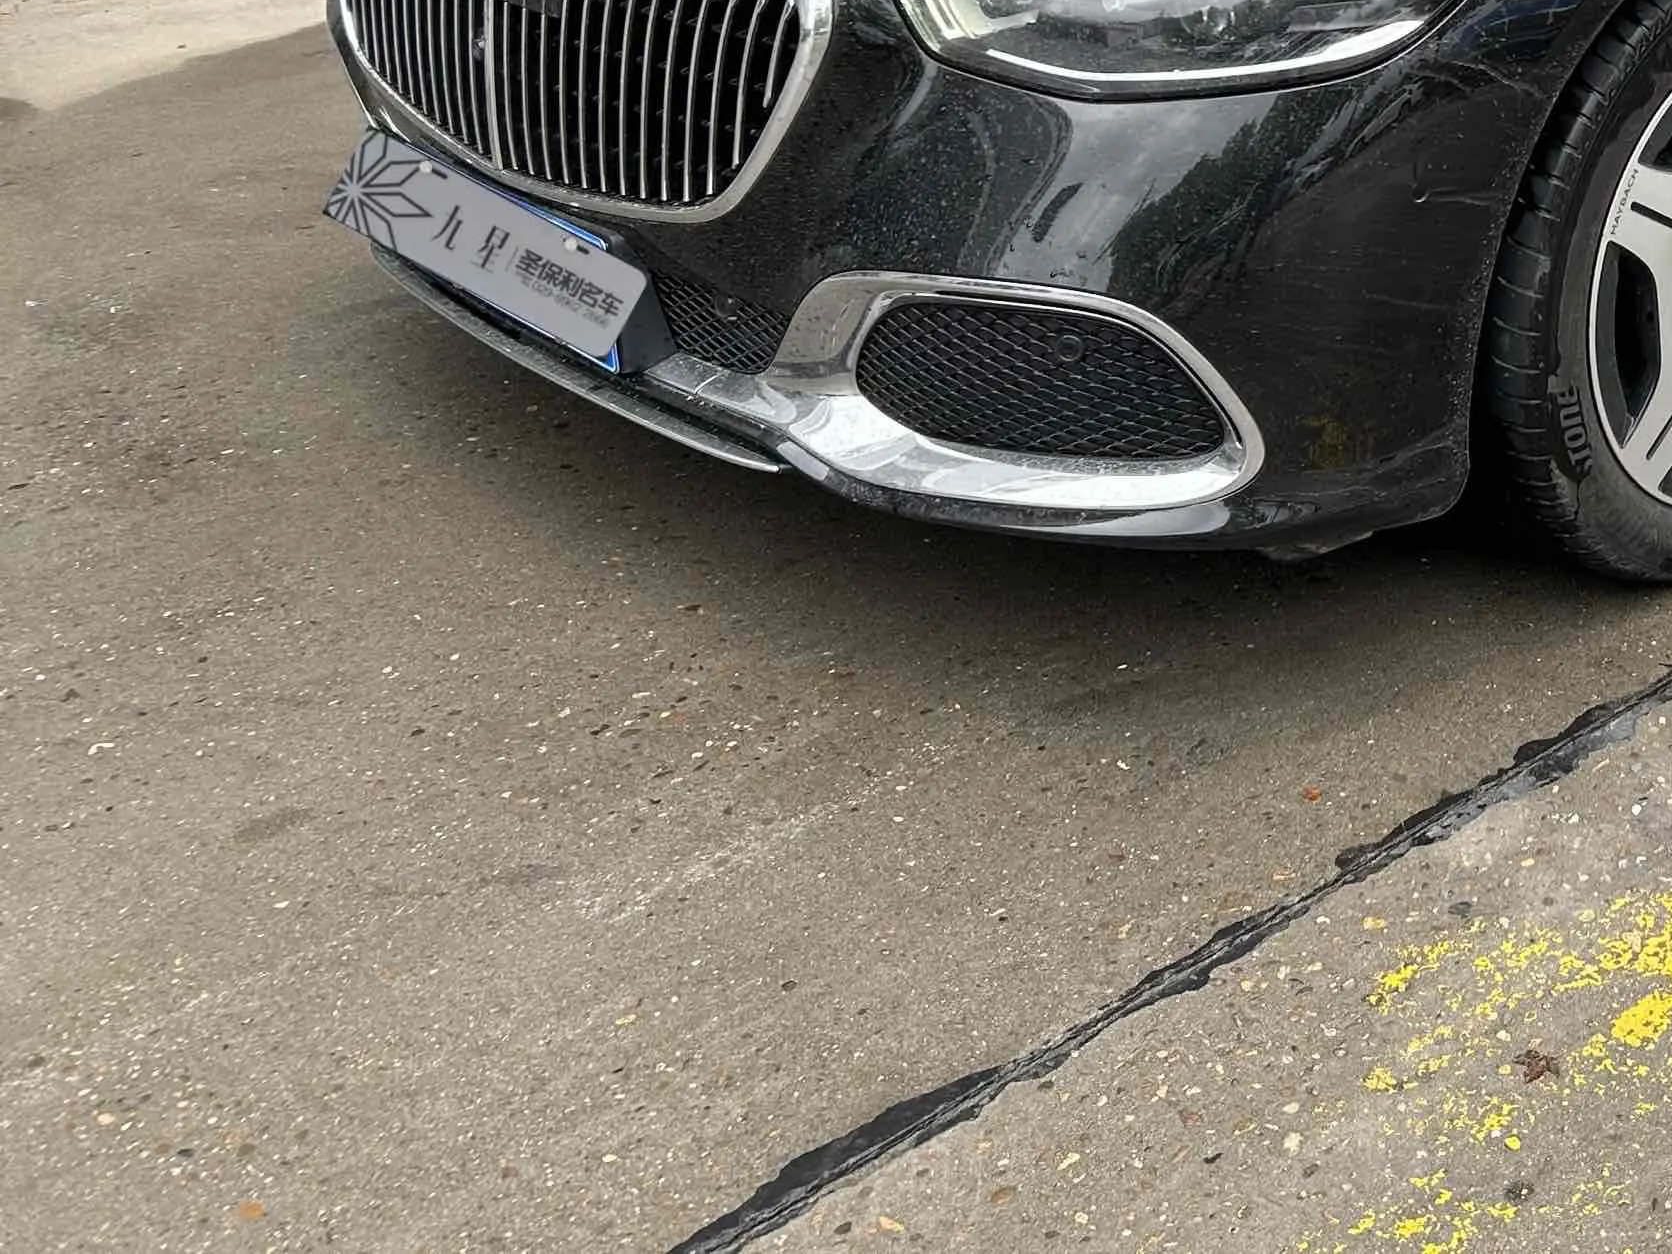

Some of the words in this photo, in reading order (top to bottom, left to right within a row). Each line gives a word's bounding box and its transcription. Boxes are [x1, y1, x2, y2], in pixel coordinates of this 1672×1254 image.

[1610, 168, 1639, 235] MAYBACH
[430, 203, 510, 275] 九星
[514, 248, 625, 317] 圣保利名车
